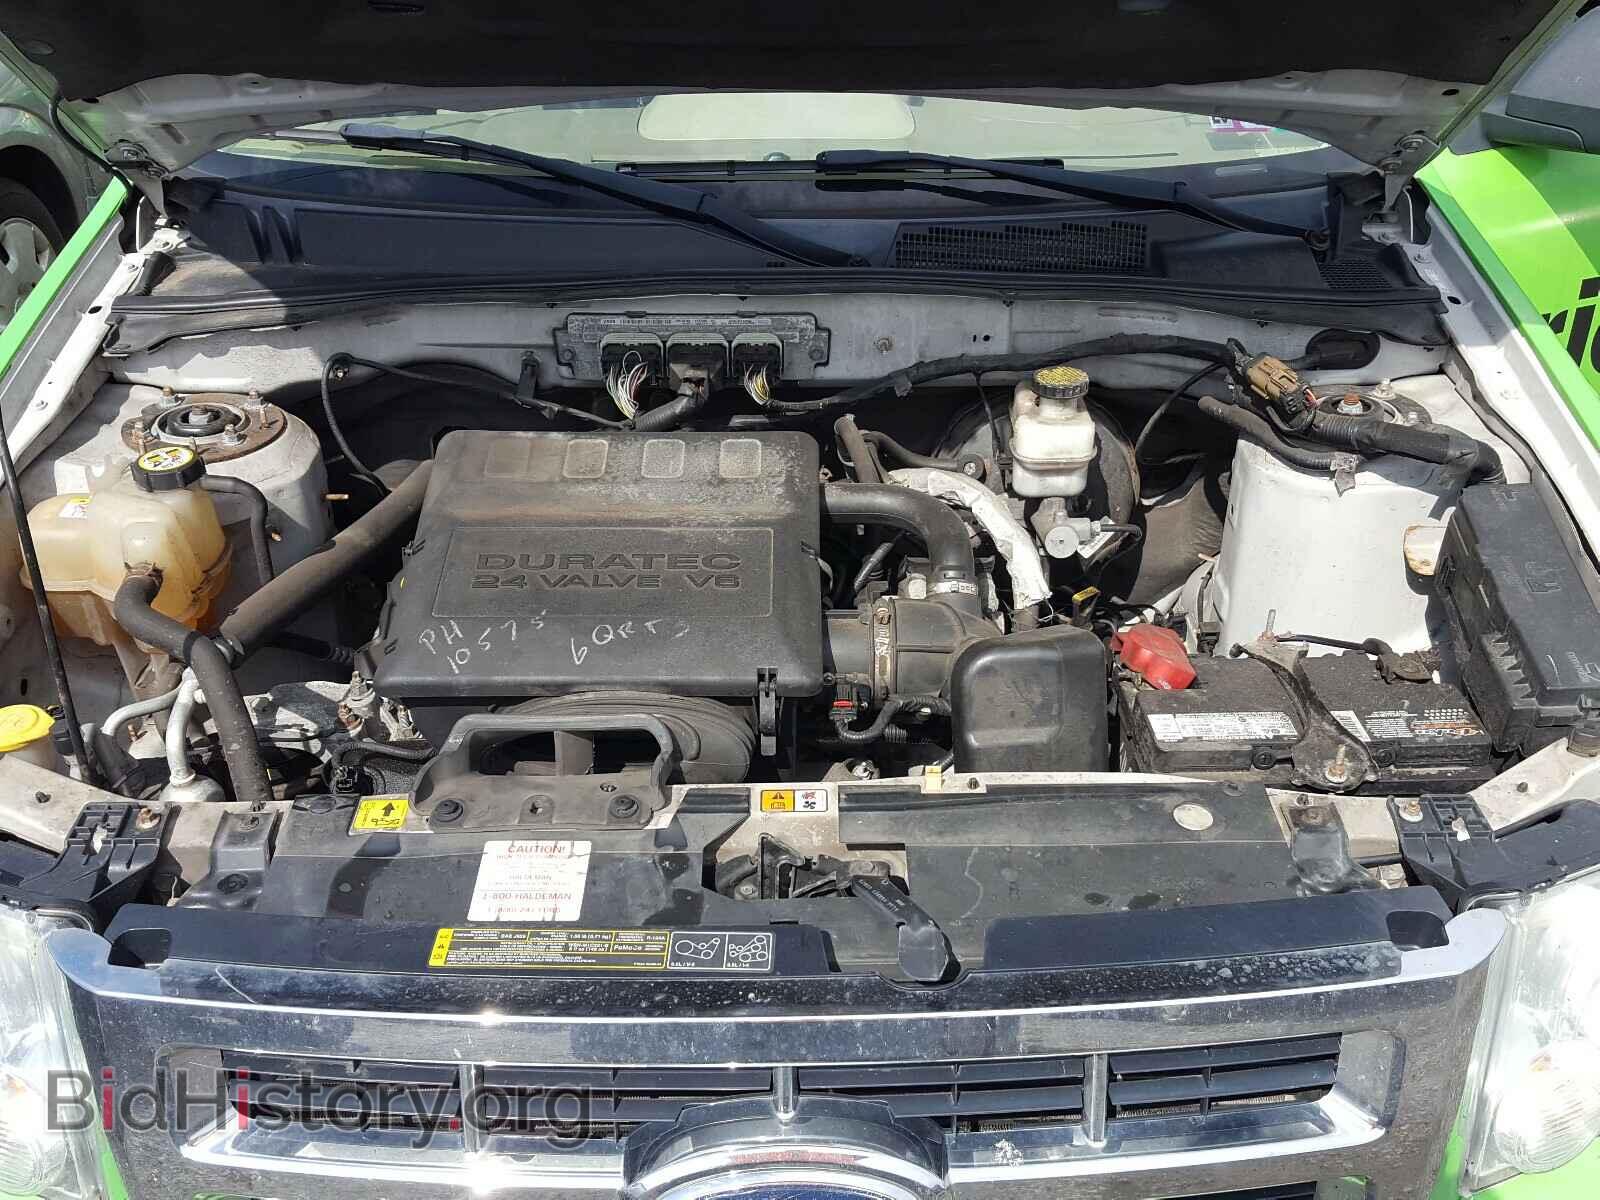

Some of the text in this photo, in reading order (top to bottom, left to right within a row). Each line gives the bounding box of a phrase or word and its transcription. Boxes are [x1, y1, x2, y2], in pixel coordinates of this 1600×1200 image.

[477, 553, 741, 571] DURATEC
[471, 574, 740, 589] 24 VALVE V6
[507, 844, 566, 854] CAUTION!
